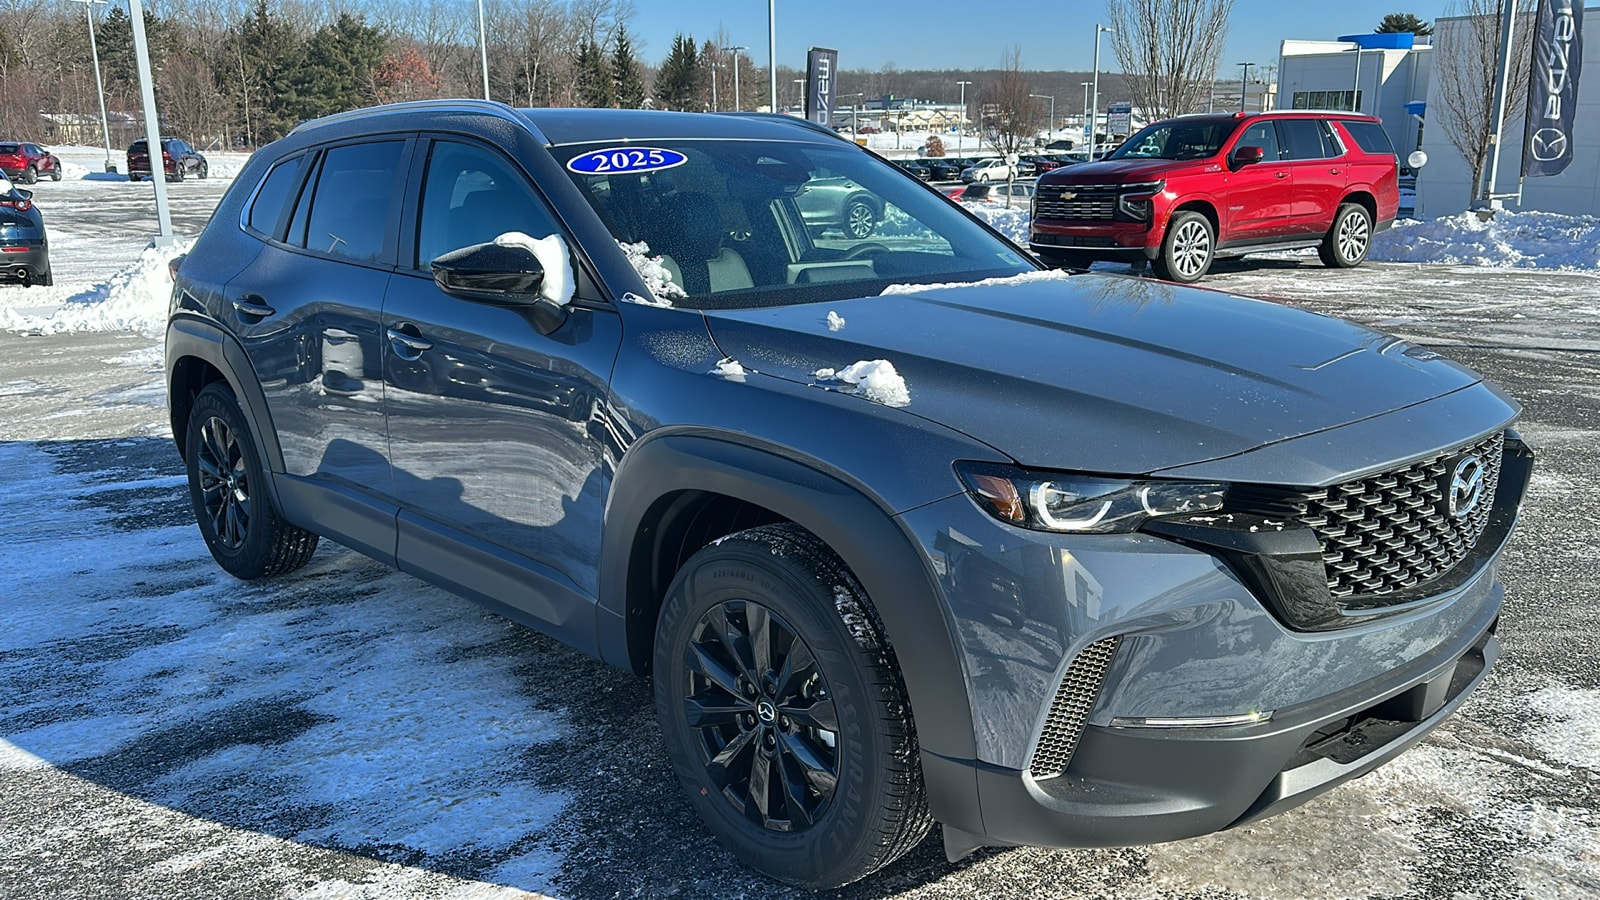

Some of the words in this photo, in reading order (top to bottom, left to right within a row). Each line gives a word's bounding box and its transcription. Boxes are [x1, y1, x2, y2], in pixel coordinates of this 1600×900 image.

[817, 58, 829, 125] mazd
[592, 150, 665, 172] 2025
[829, 682, 864, 852] ASSURANCE
